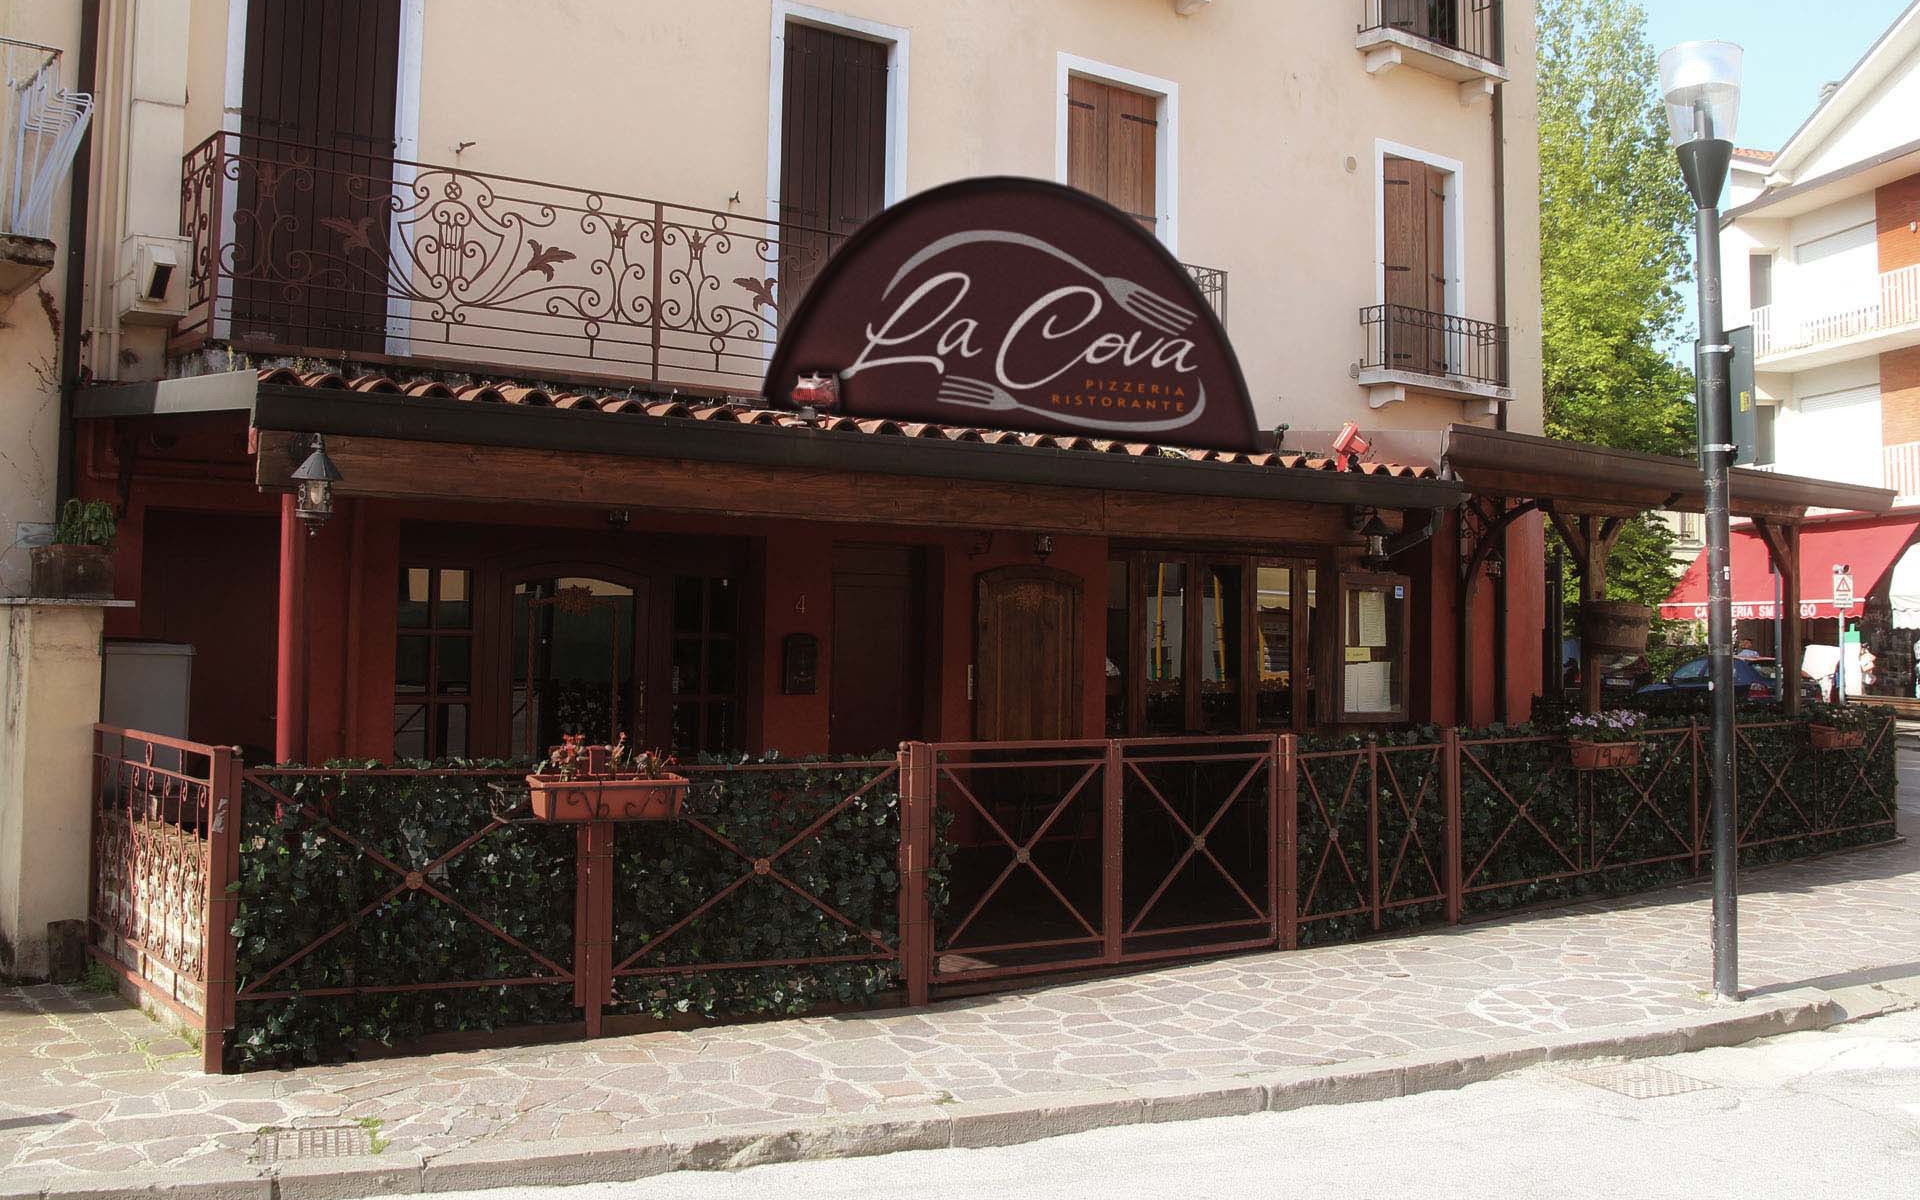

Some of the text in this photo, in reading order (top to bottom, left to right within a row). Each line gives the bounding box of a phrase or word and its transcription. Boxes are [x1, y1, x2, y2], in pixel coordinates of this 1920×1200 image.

[840, 271, 1200, 390] La Cova
[1085, 379, 1185, 397] PIZZERIA
[1051, 393, 1185, 413] RISTORANTE
[795, 594, 806, 614] 4
